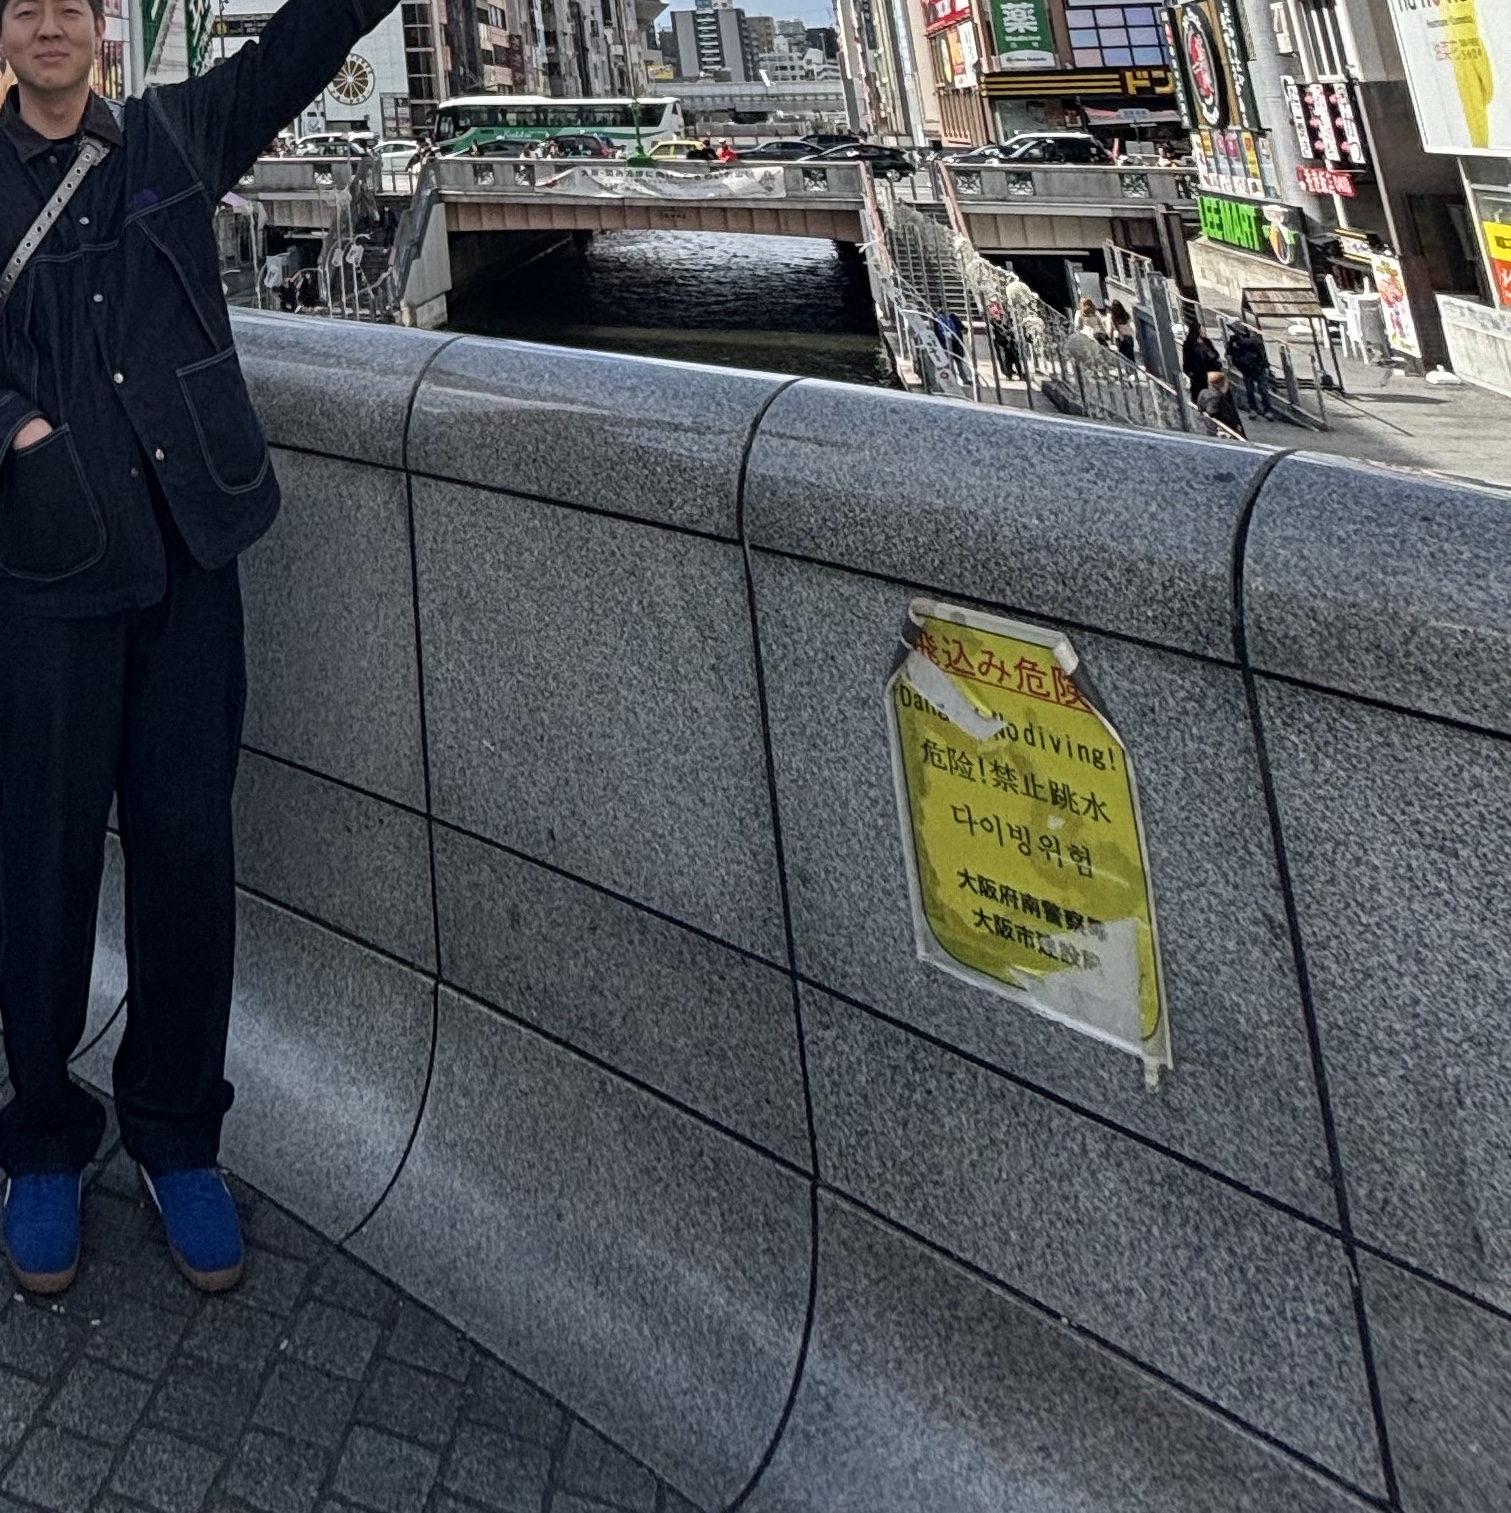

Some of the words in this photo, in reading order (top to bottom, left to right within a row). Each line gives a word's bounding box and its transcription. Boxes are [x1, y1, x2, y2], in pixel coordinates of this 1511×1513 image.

[1000, 1, 1039, 34] 薬
[1023, 720, 1118, 774] diving!
[921, 738, 1112, 825] 危险!禁止跳水
